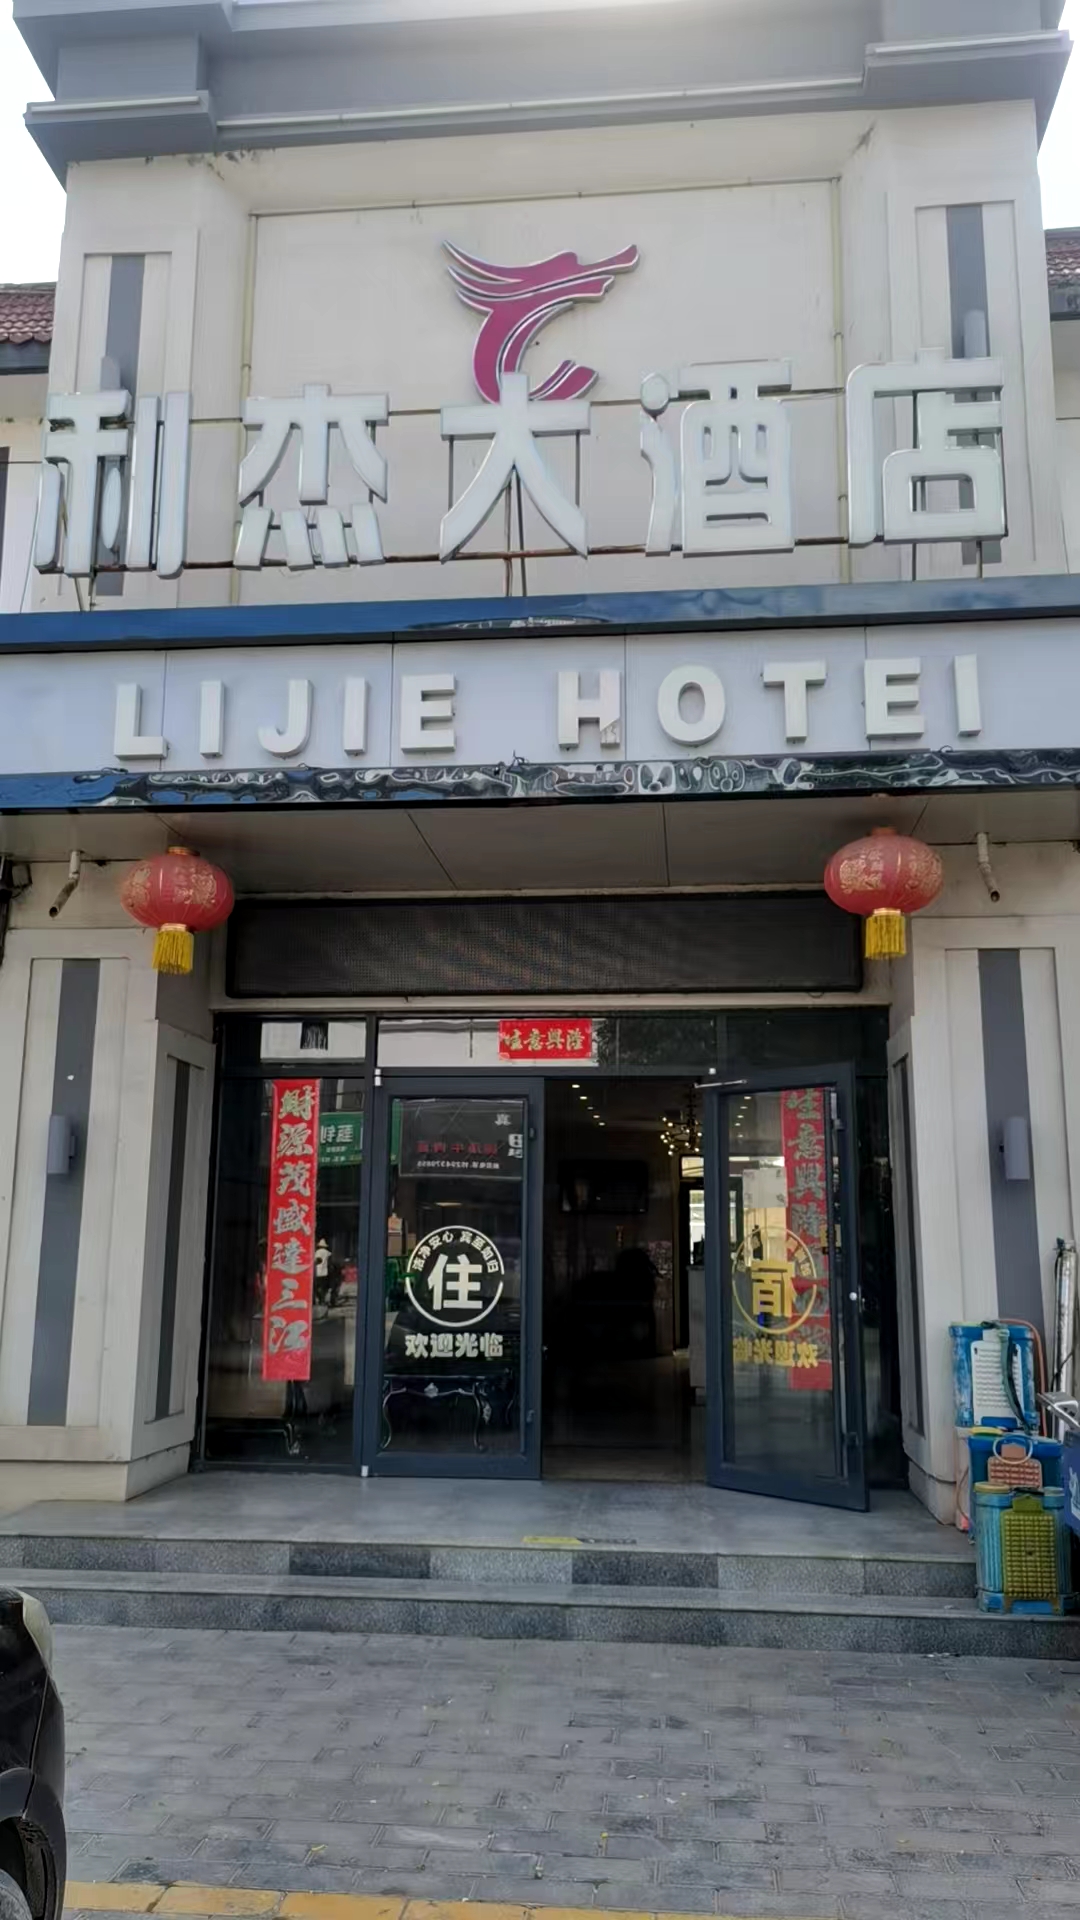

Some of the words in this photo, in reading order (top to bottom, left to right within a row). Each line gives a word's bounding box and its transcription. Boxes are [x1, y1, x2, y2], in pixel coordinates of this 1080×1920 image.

[34, 355, 1008, 578] 利杰大酒店
[113, 673, 457, 761] LIJIE
[427, 1253, 483, 1311] 住
[404, 1332, 504, 1359] 欢迎光临
